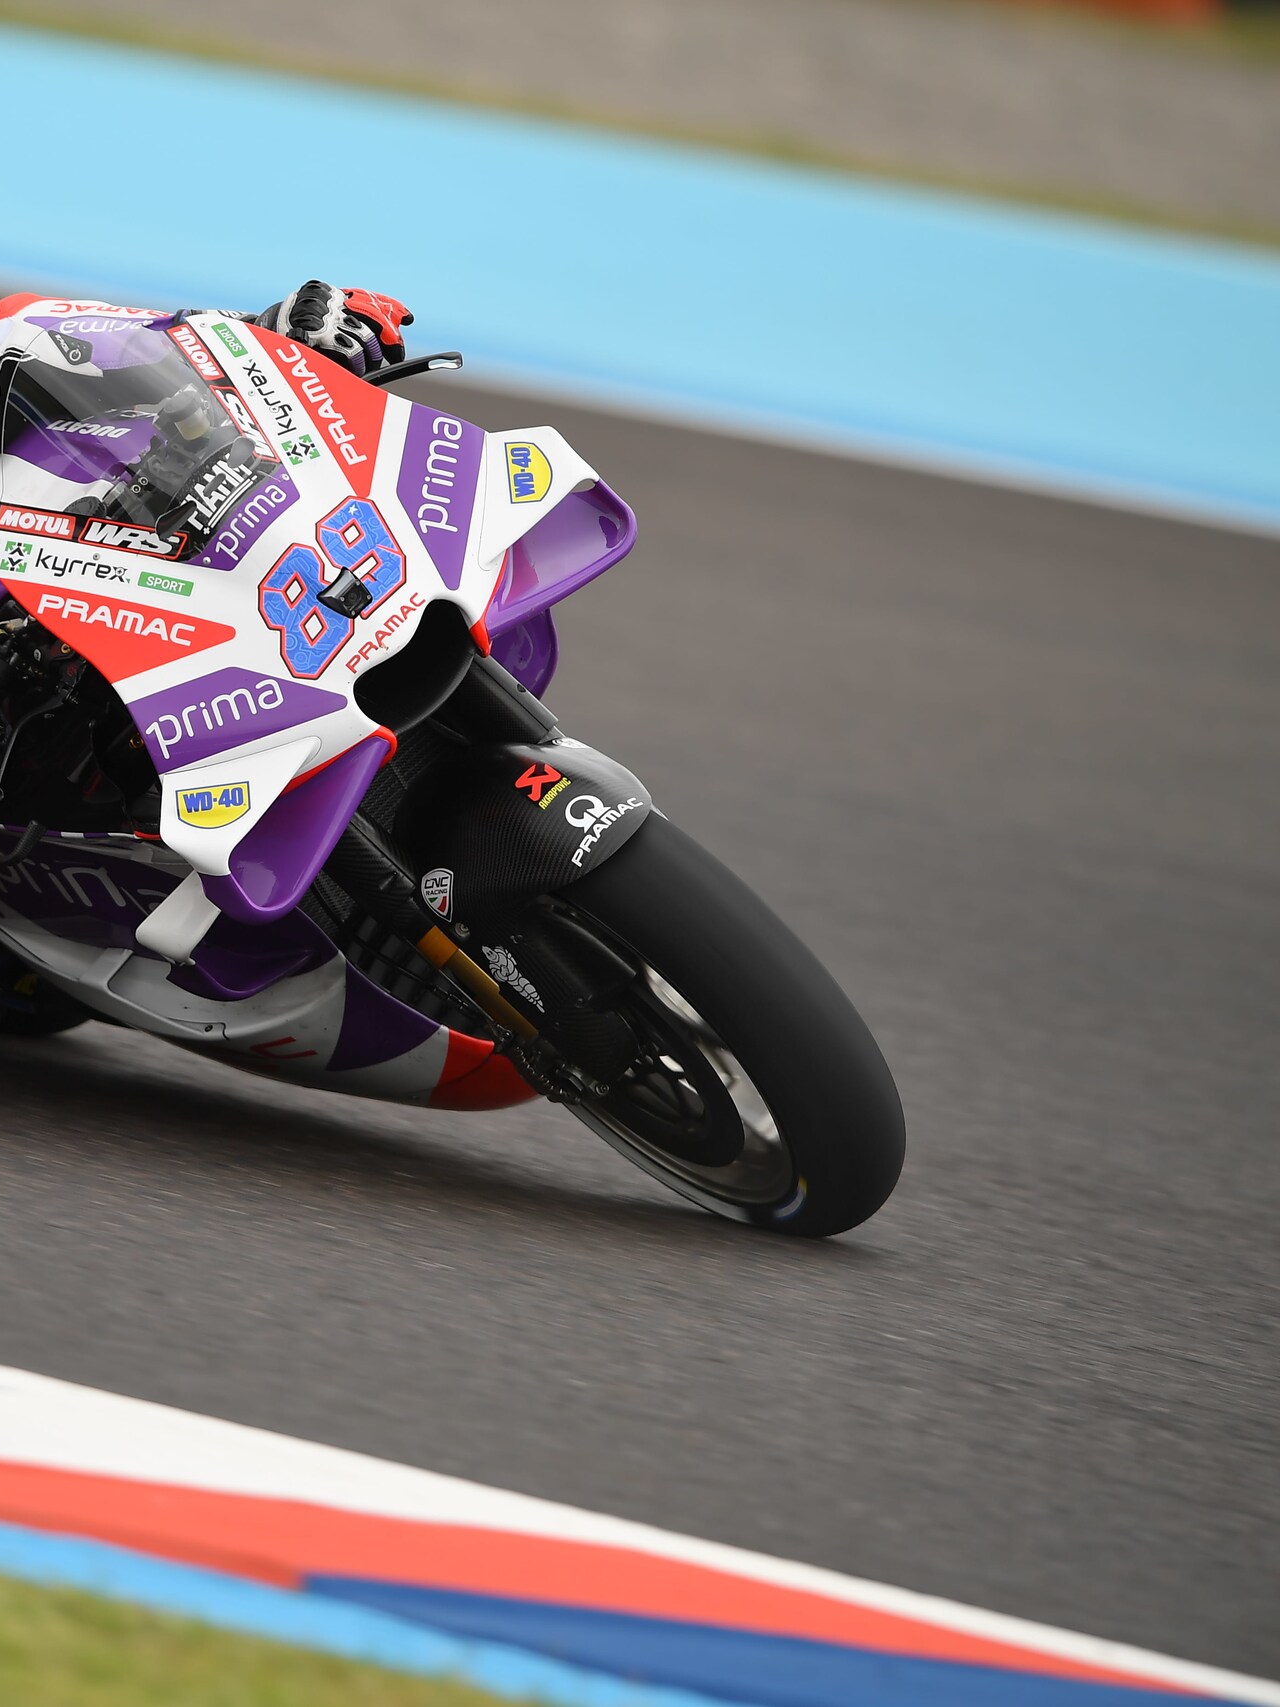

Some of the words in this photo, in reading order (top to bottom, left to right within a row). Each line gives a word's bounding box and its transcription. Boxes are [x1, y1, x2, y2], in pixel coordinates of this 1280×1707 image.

[173, 327, 220, 377] MOTUL
[218, 326, 241, 352] SPORT
[242, 360, 296, 435] kyrrex
[276, 344, 367, 465] PRAMAC
[46, 421, 131, 438] DUCATI
[418, 416, 462, 533] prima
[511, 446, 536, 498] WD-40
[84, 522, 179, 554] WRS
[215, 483, 287, 561] prima
[35, 548, 128, 583] kyrrex
[146, 576, 185, 593] SPORT
[258, 495, 407, 680] 89
[37, 594, 196, 646] PRAMAC
[345, 592, 426, 674] PRAMAC
[146, 679, 284, 759] prima
[183, 787, 245, 813] WD-40
[571, 797, 644, 867] PRAMAC
[424, 876, 449, 889] CNC
[425, 888, 448, 896] RACING
